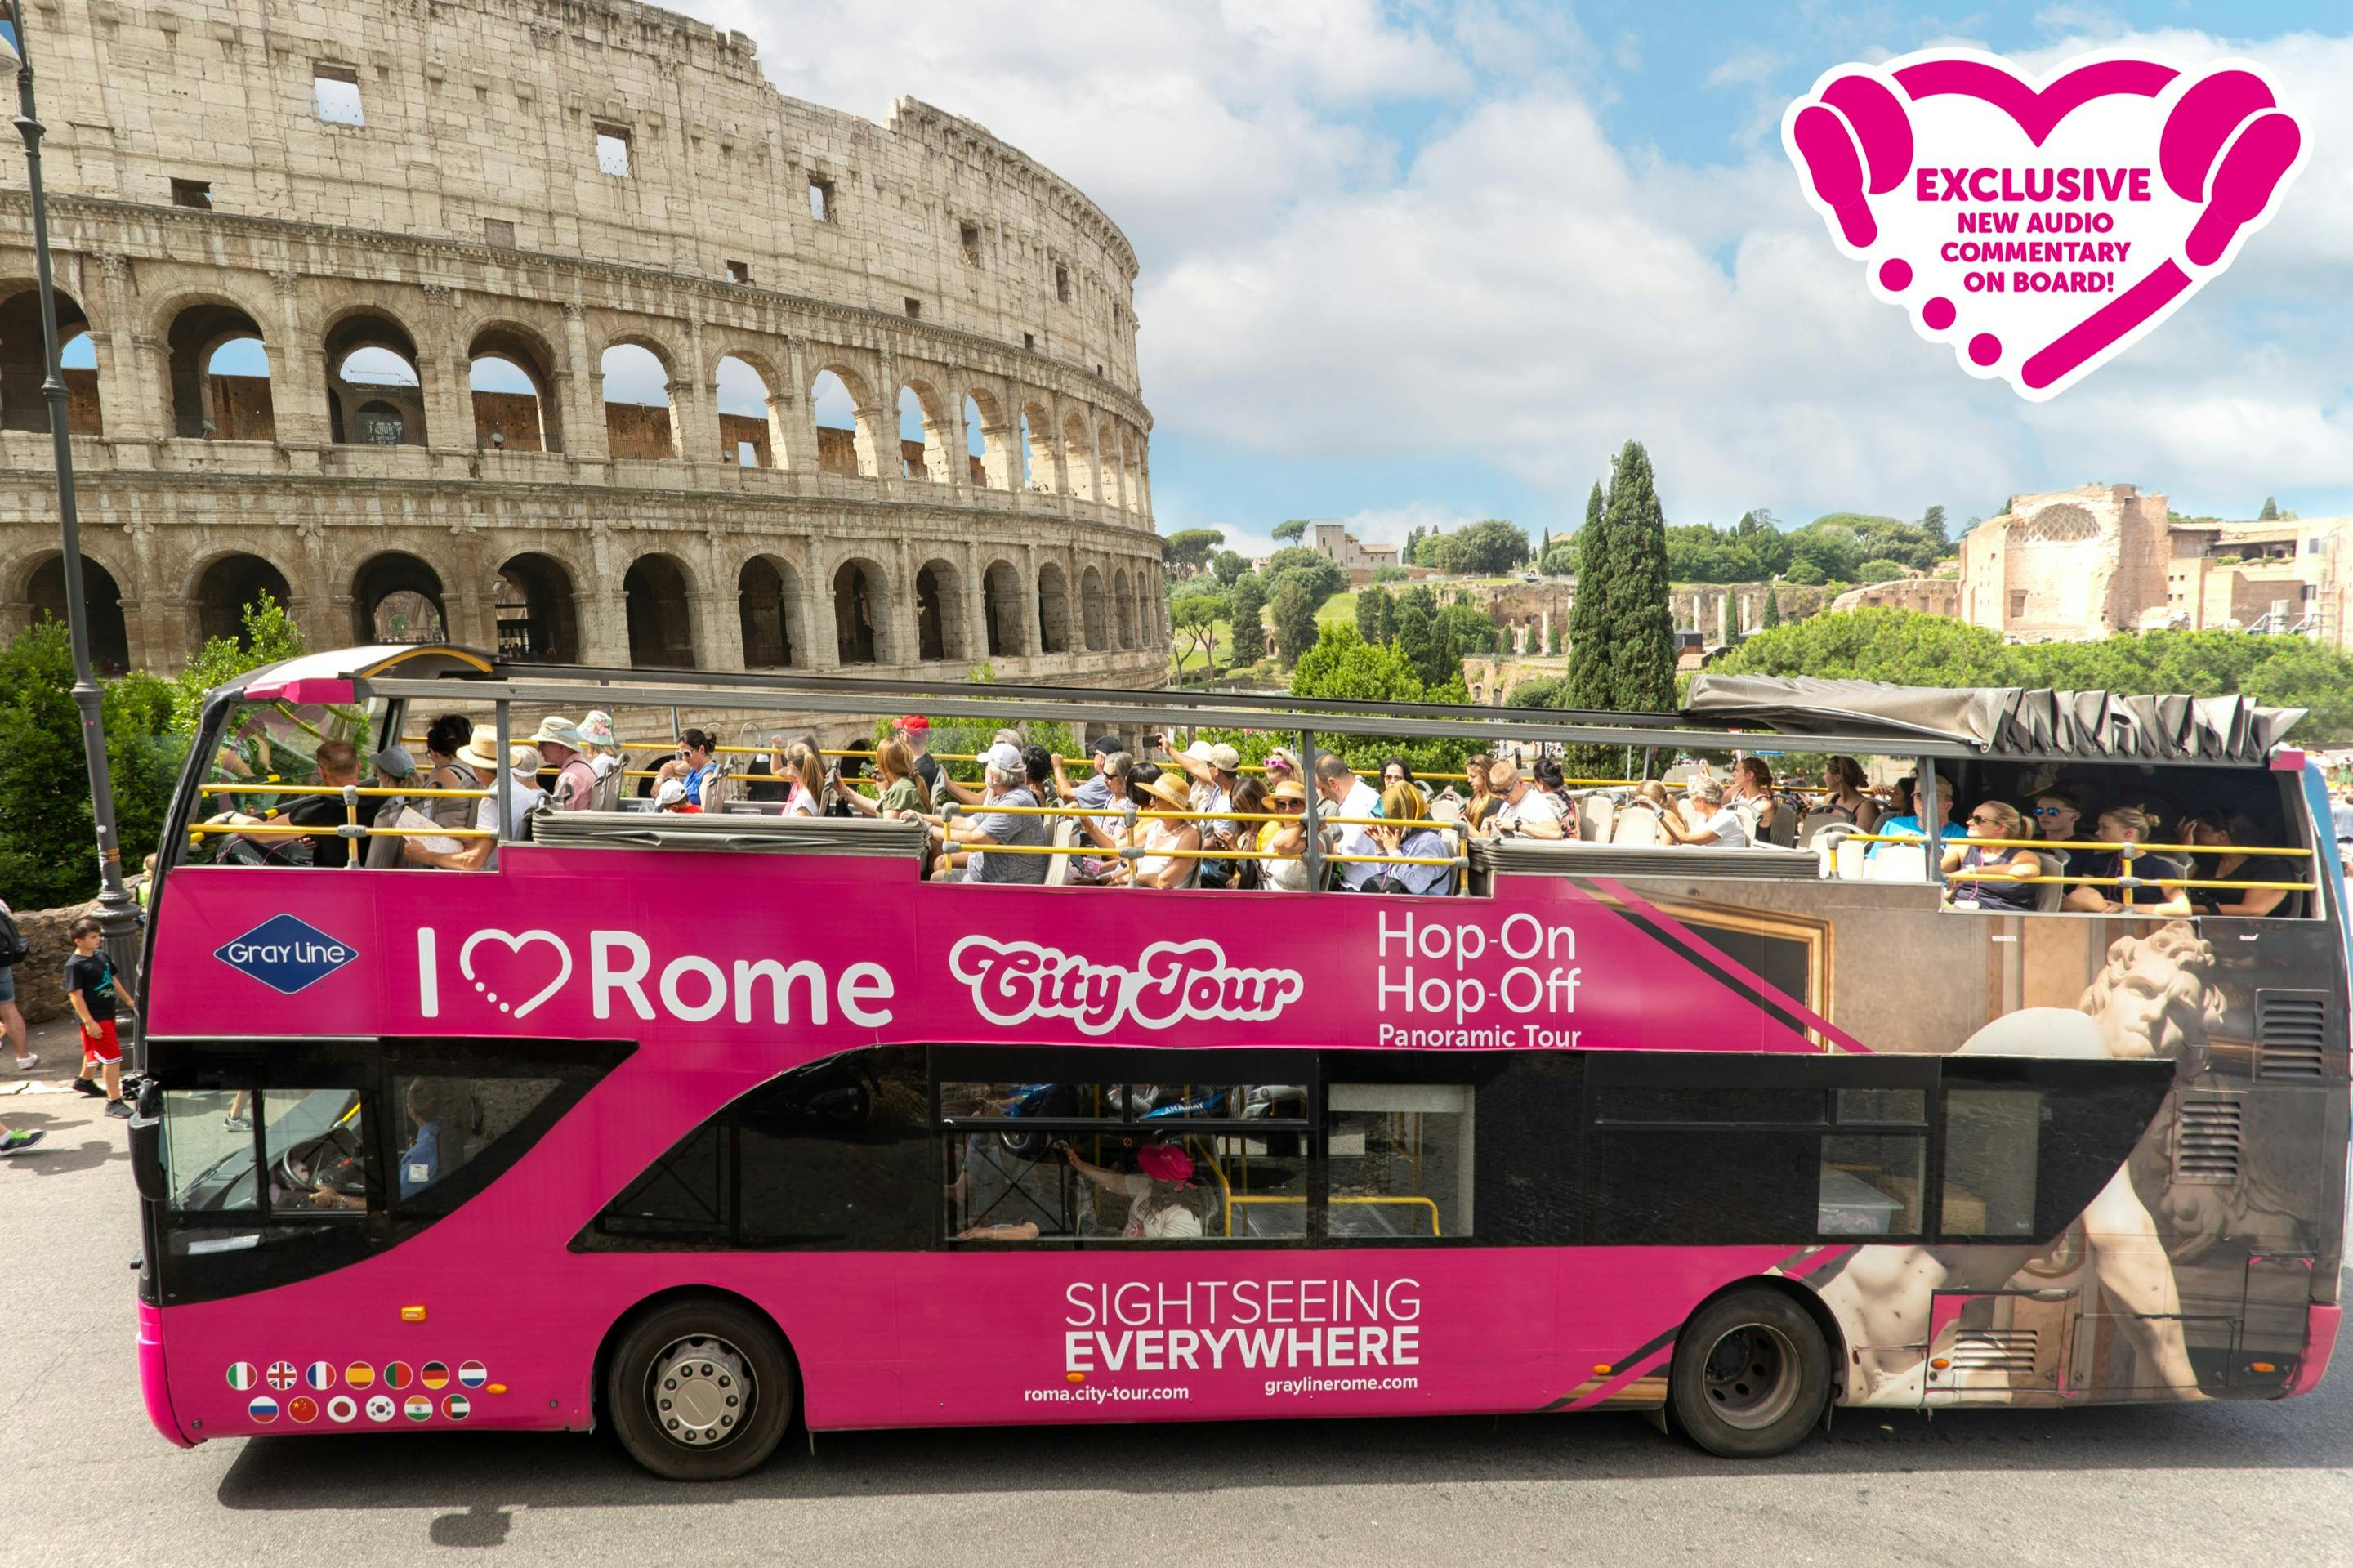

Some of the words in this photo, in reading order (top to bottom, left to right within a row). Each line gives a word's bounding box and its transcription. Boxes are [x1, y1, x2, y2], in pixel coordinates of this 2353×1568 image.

[228, 943, 291, 963] Gray
[295, 941, 345, 963] Line
[1378, 911, 1576, 972] Hop-On
[417, 927, 439, 1018] I
[590, 930, 895, 1028] Rome
[953, 939, 1123, 1031] City
[1133, 943, 1299, 1023] Tour
[1377, 964, 1583, 1025] Hop-Off
[1379, 1023, 1516, 1048] Panoramic
[1523, 1024, 1582, 1048] Tour
[1065, 1278, 1421, 1326] SIGHTSEEING
[1065, 1325, 1420, 1372] EVERYWHERE
[1025, 1385, 1190, 1405] roma.city-tour.com
[1264, 1375, 1418, 1396] graylinerome.com
